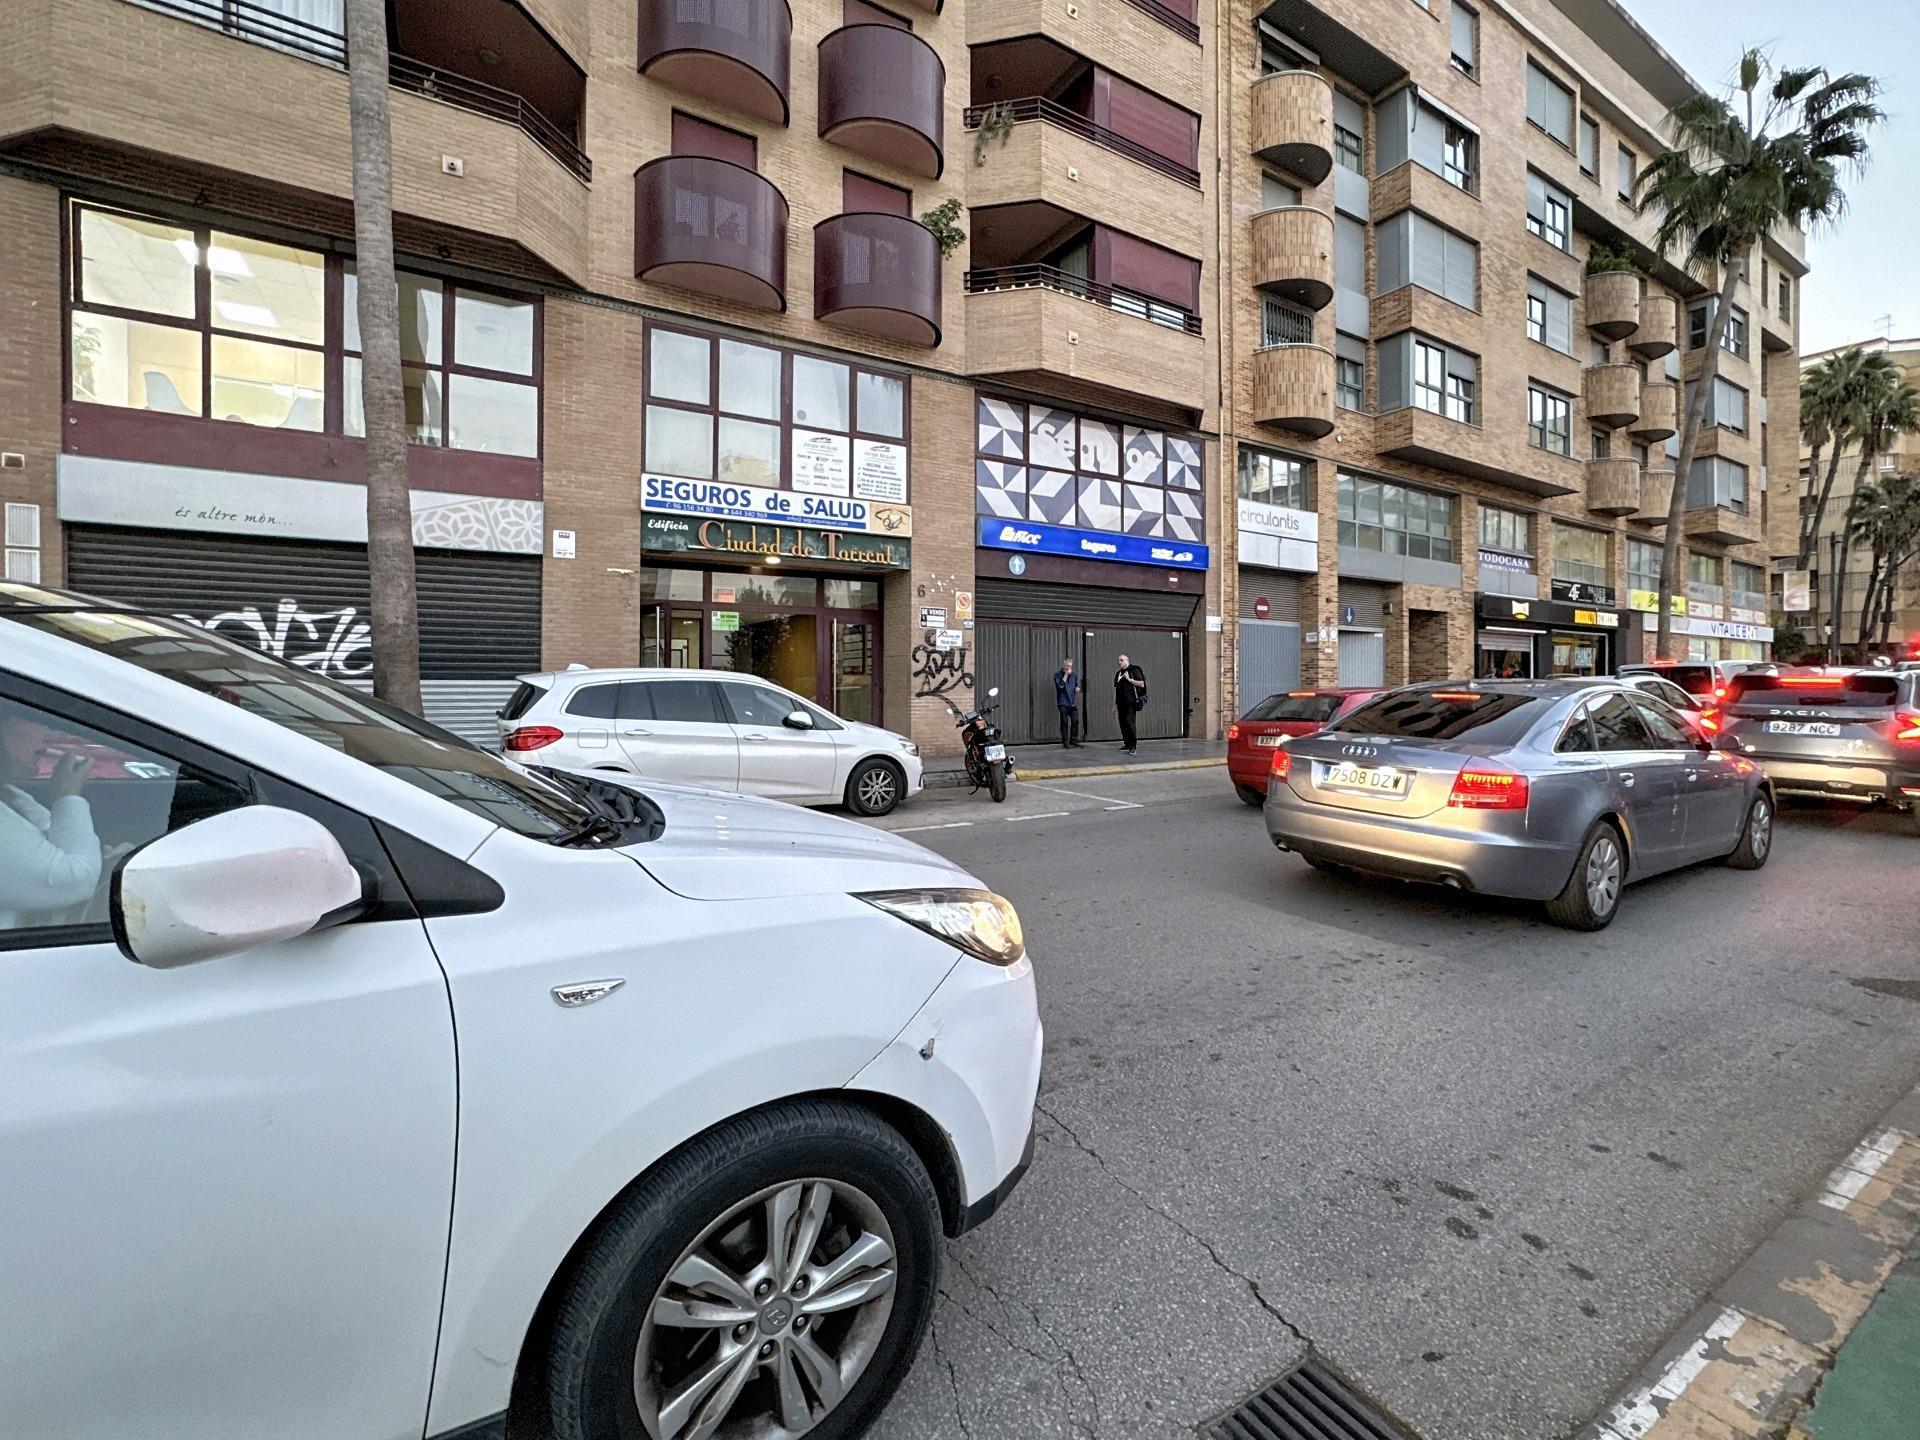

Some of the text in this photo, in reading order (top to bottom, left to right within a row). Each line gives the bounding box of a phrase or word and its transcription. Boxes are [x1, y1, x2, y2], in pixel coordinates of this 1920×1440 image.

[646, 478, 866, 520] SEGUROS de SALUD
[198, 506, 238, 521] altre
[1240, 508, 1300, 530] circulantis
[648, 519, 689, 532] Edificio
[698, 519, 892, 564] Ciudad de Torrent
[1478, 551, 1530, 569] TODOCASA
[917, 585, 926, 598] 6
[929, 608, 946, 616] VENDE
[1769, 709, 1830, 717] DACIA
[1772, 722, 1836, 735] 9287 NCC
[1332, 768, 1402, 790] 7508 DZW
